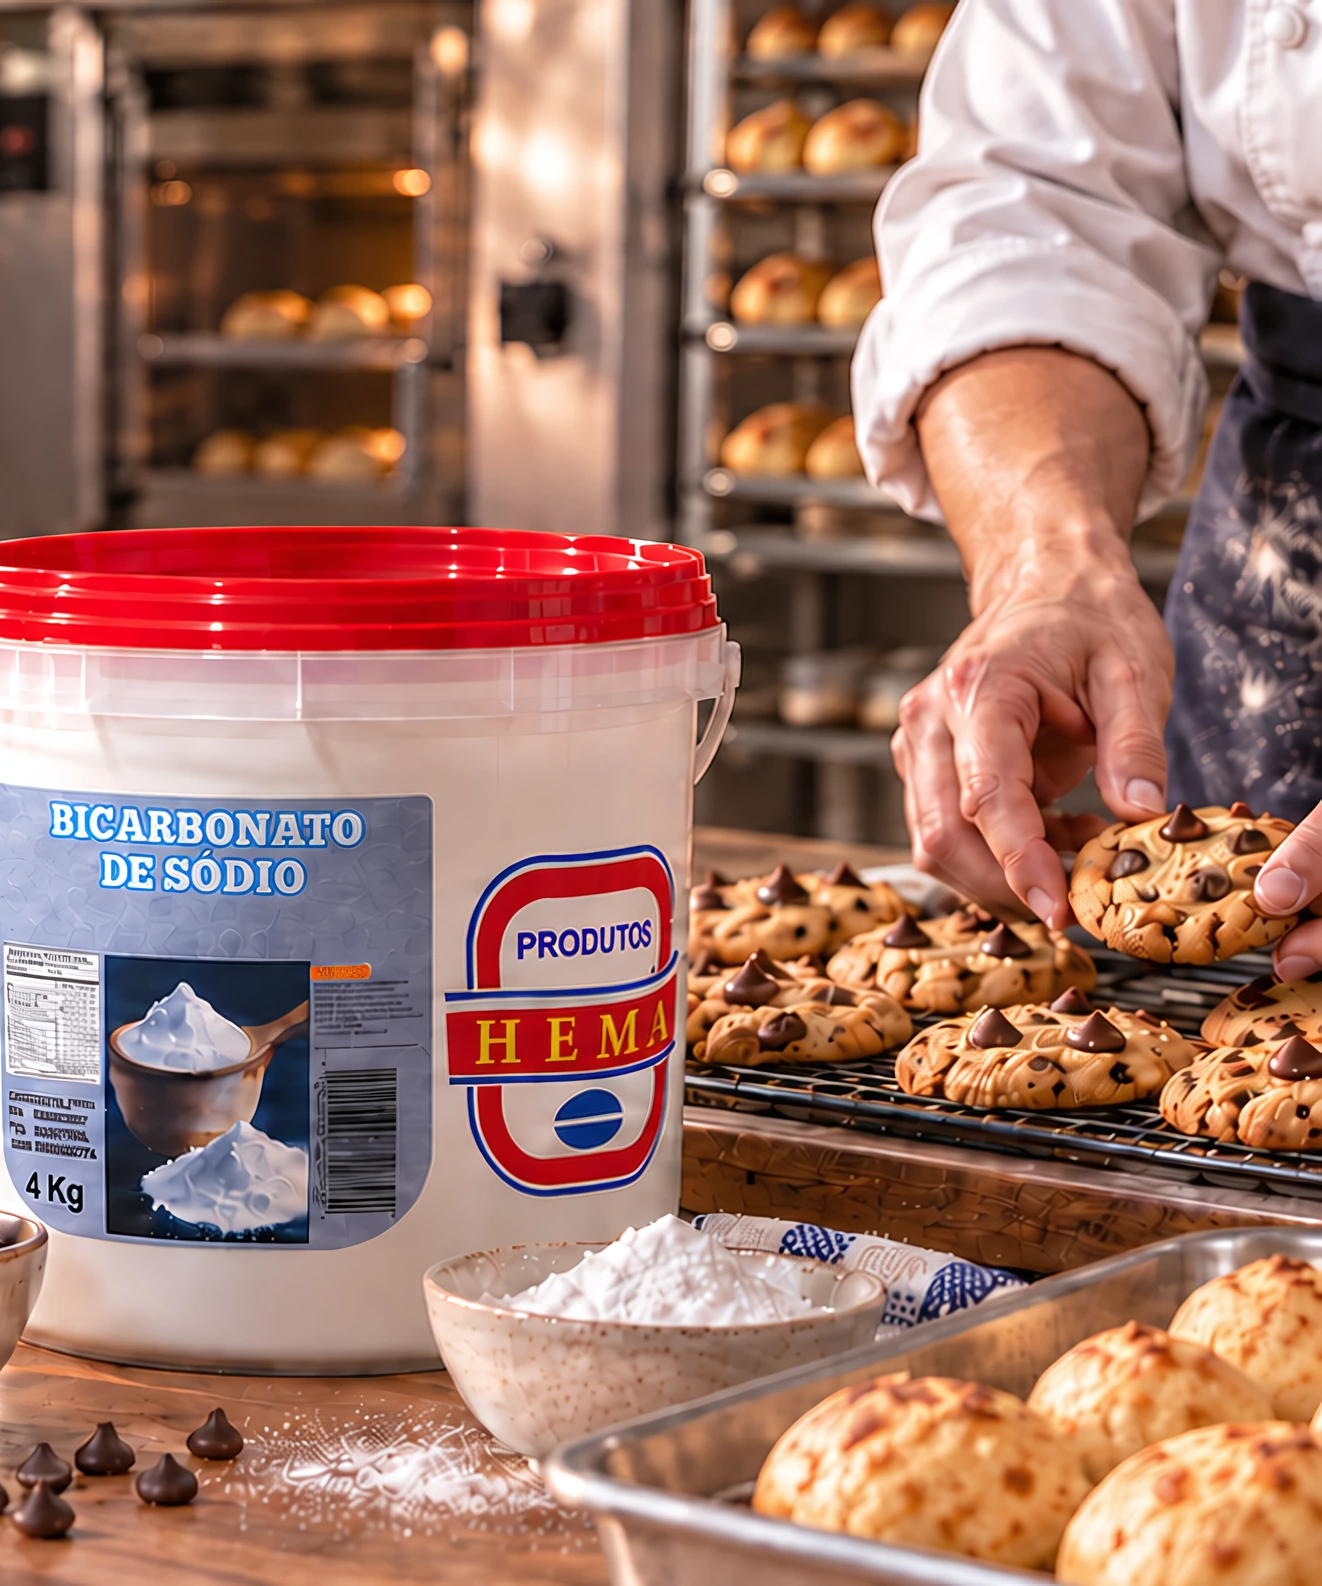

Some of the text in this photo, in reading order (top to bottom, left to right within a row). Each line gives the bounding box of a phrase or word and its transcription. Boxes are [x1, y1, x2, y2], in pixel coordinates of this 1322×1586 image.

[49, 802, 363, 848] BICARBONATO
[100, 849, 305, 894] DE SÓDIO
[517, 919, 653, 960] PRODUTOS
[475, 999, 669, 1065] HEMA
[25, 1171, 84, 1214] 4 Kg
